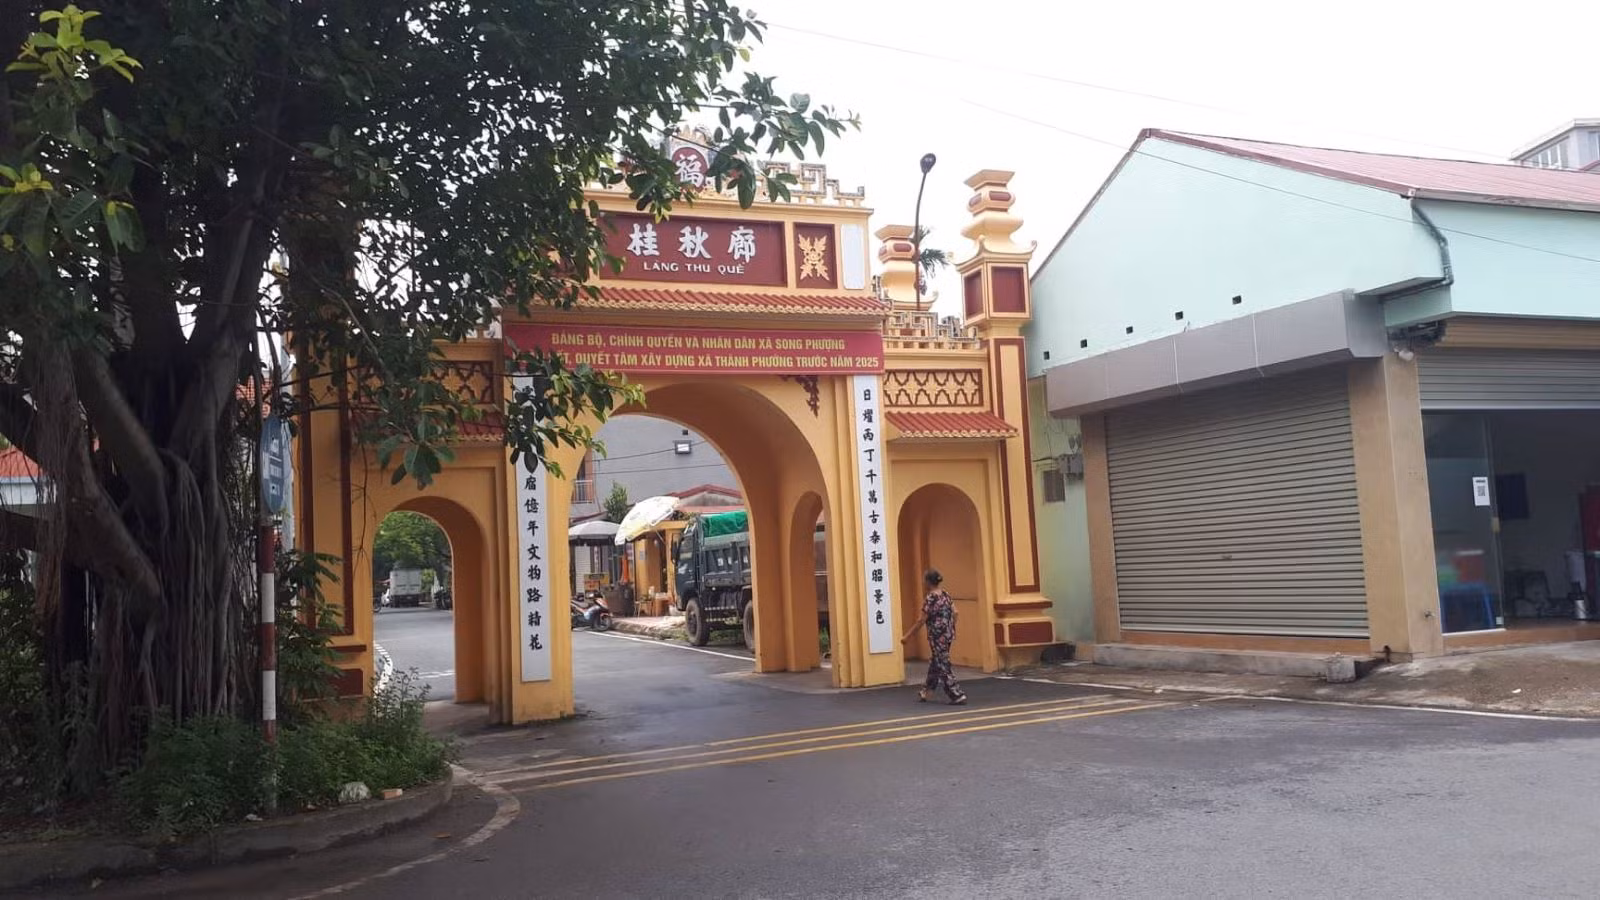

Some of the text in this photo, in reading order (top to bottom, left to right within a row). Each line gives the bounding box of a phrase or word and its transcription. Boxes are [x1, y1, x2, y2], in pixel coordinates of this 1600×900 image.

[643, 259, 746, 275] LÀNG THU QUẾ
[551, 330, 584, 345] ĐẢNG
[587, 333, 606, 349] BỘ,
[609, 333, 644, 347] CHÍNH
[647, 334, 683, 349] QUYỀN
[685, 335, 700, 349] VÀ
[702, 336, 732, 349] NHÂN
[734, 336, 756, 349] DÂN
[758, 336, 772, 350] XÃ
[775, 338, 803, 350] SONG
[613, 351, 638, 366] TÂM
[641, 352, 662, 366] XÂY
[665, 354, 695, 368] DỰNG
[698, 354, 713, 367] XÃ
[796, 354, 828, 368] TRƯỚC
[830, 354, 853, 368] NĂM
[855, 356, 879, 368] 2025
